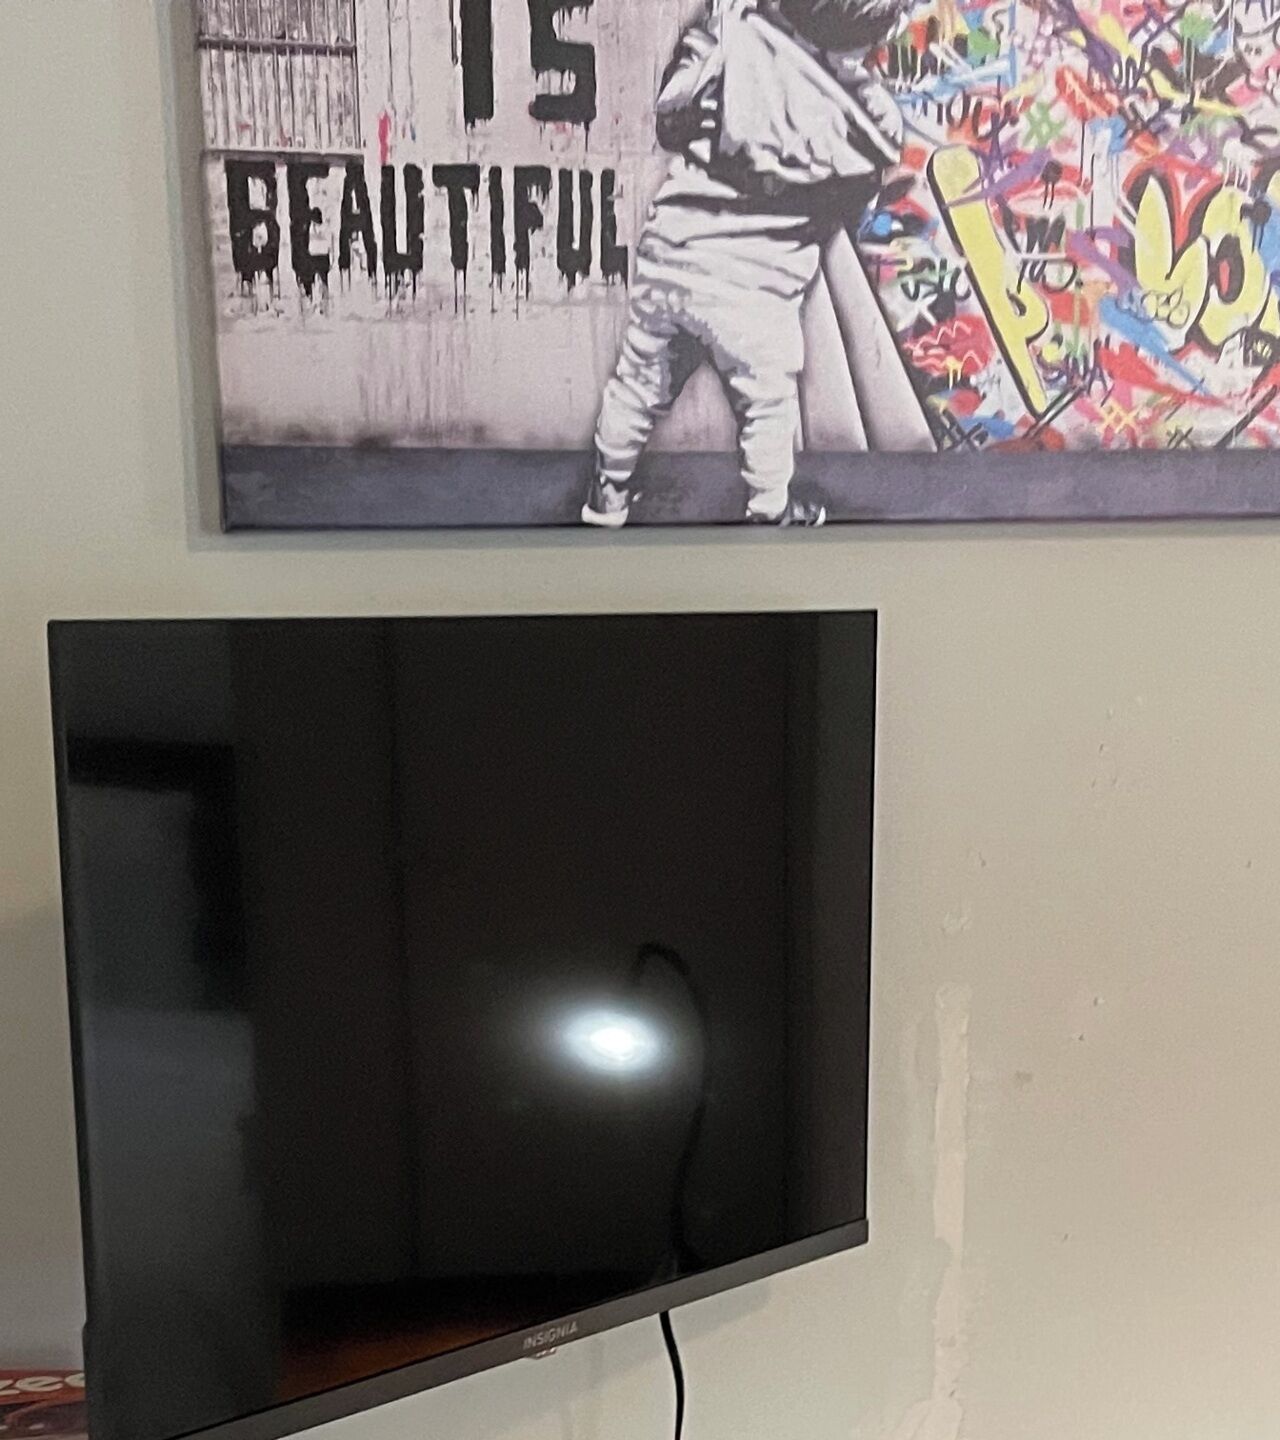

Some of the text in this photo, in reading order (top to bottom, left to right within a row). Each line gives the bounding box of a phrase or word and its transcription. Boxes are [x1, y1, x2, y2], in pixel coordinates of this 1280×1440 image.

[461, 0, 597, 124] IS
[226, 160, 628, 295] BEAUTIFUL
[522, 1321, 579, 1350] INSIGNIA
